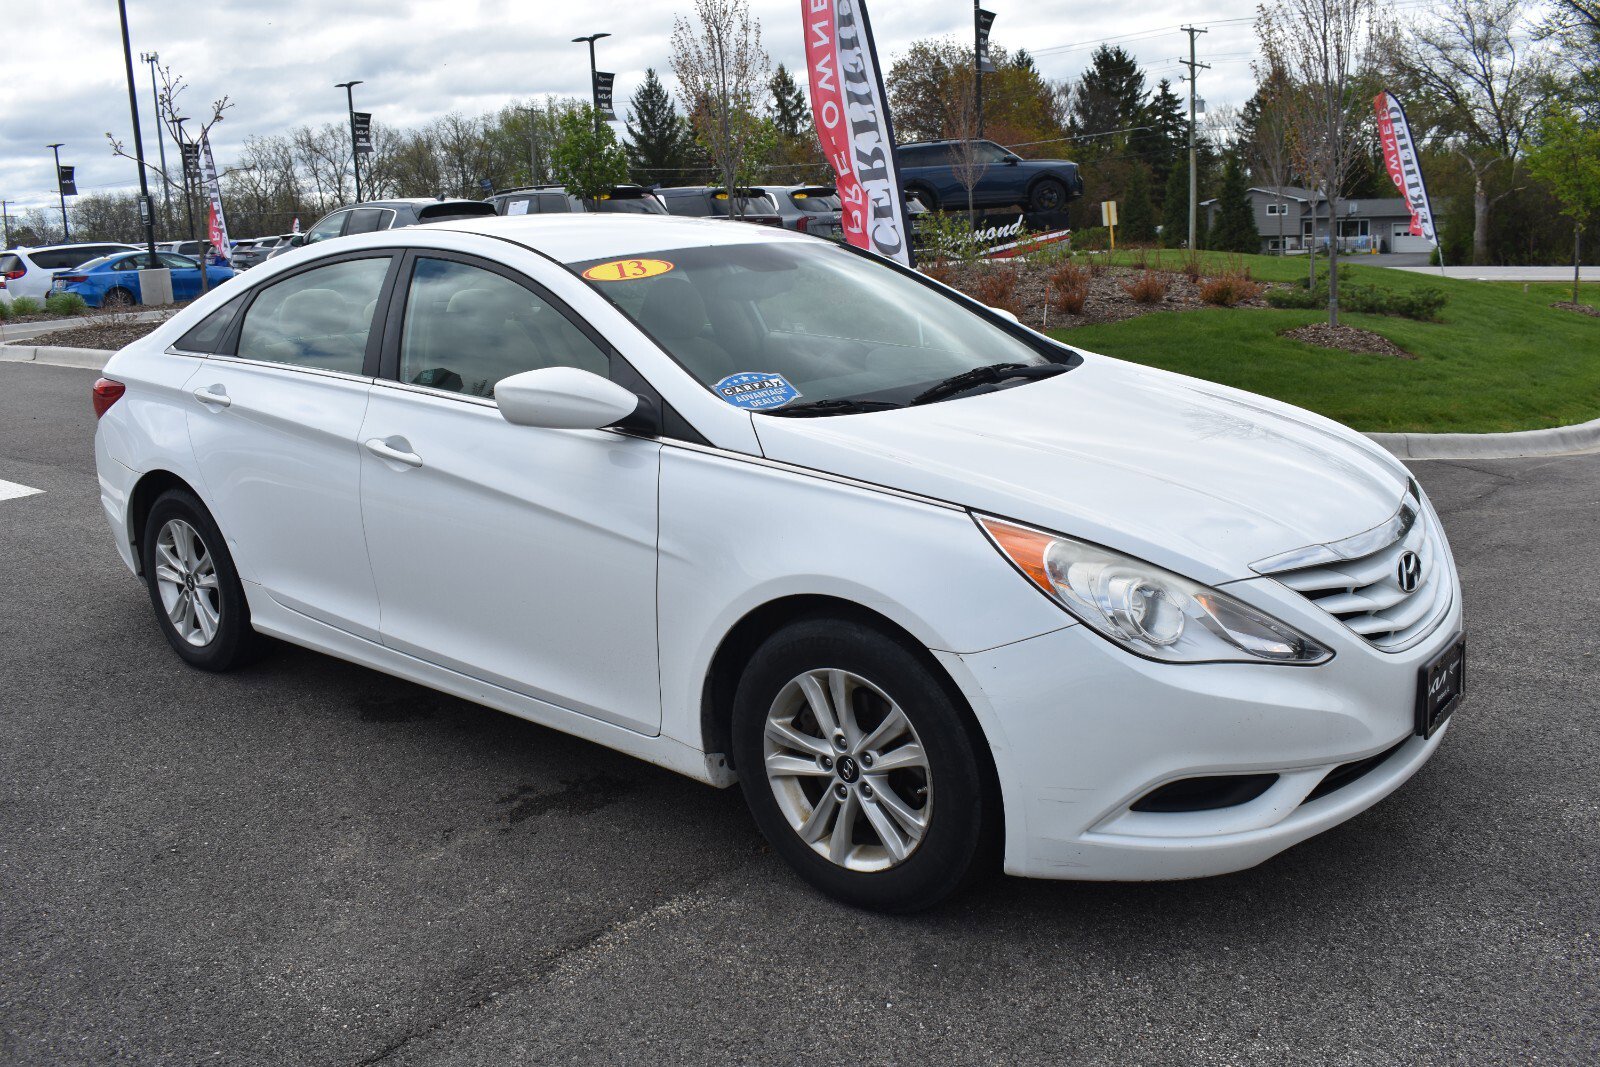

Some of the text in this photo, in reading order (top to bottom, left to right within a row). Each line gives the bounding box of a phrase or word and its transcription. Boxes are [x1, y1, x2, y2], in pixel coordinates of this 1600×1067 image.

[613, 260, 647, 279] 13
[722, 379, 783, 396] CARFAX
[735, 387, 787, 402] ADVANTAGE
[750, 396, 786, 407] DEALER
